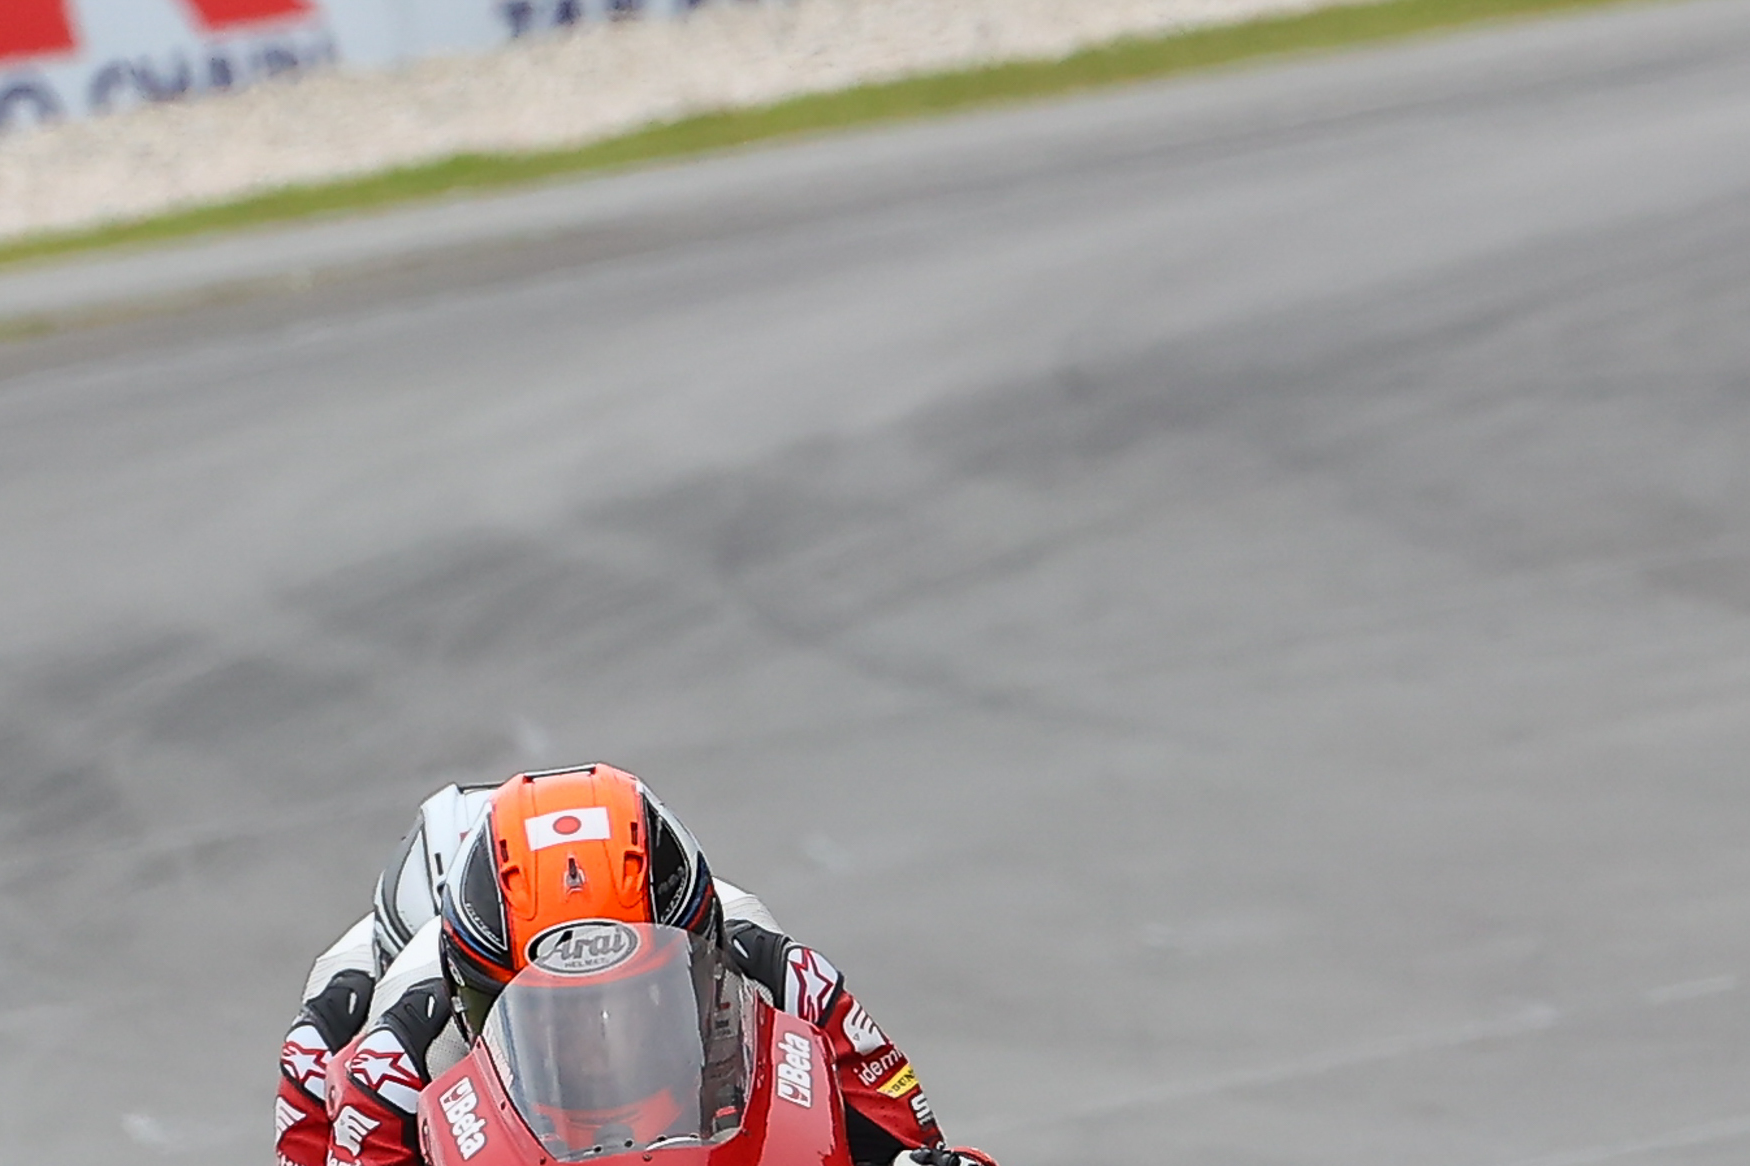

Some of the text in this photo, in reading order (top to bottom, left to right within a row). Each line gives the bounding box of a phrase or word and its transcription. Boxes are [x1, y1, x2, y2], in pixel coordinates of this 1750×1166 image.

[534, 926, 626, 963] Arai
[778, 1032, 811, 1093] Beta
[445, 1092, 486, 1161] Beta
